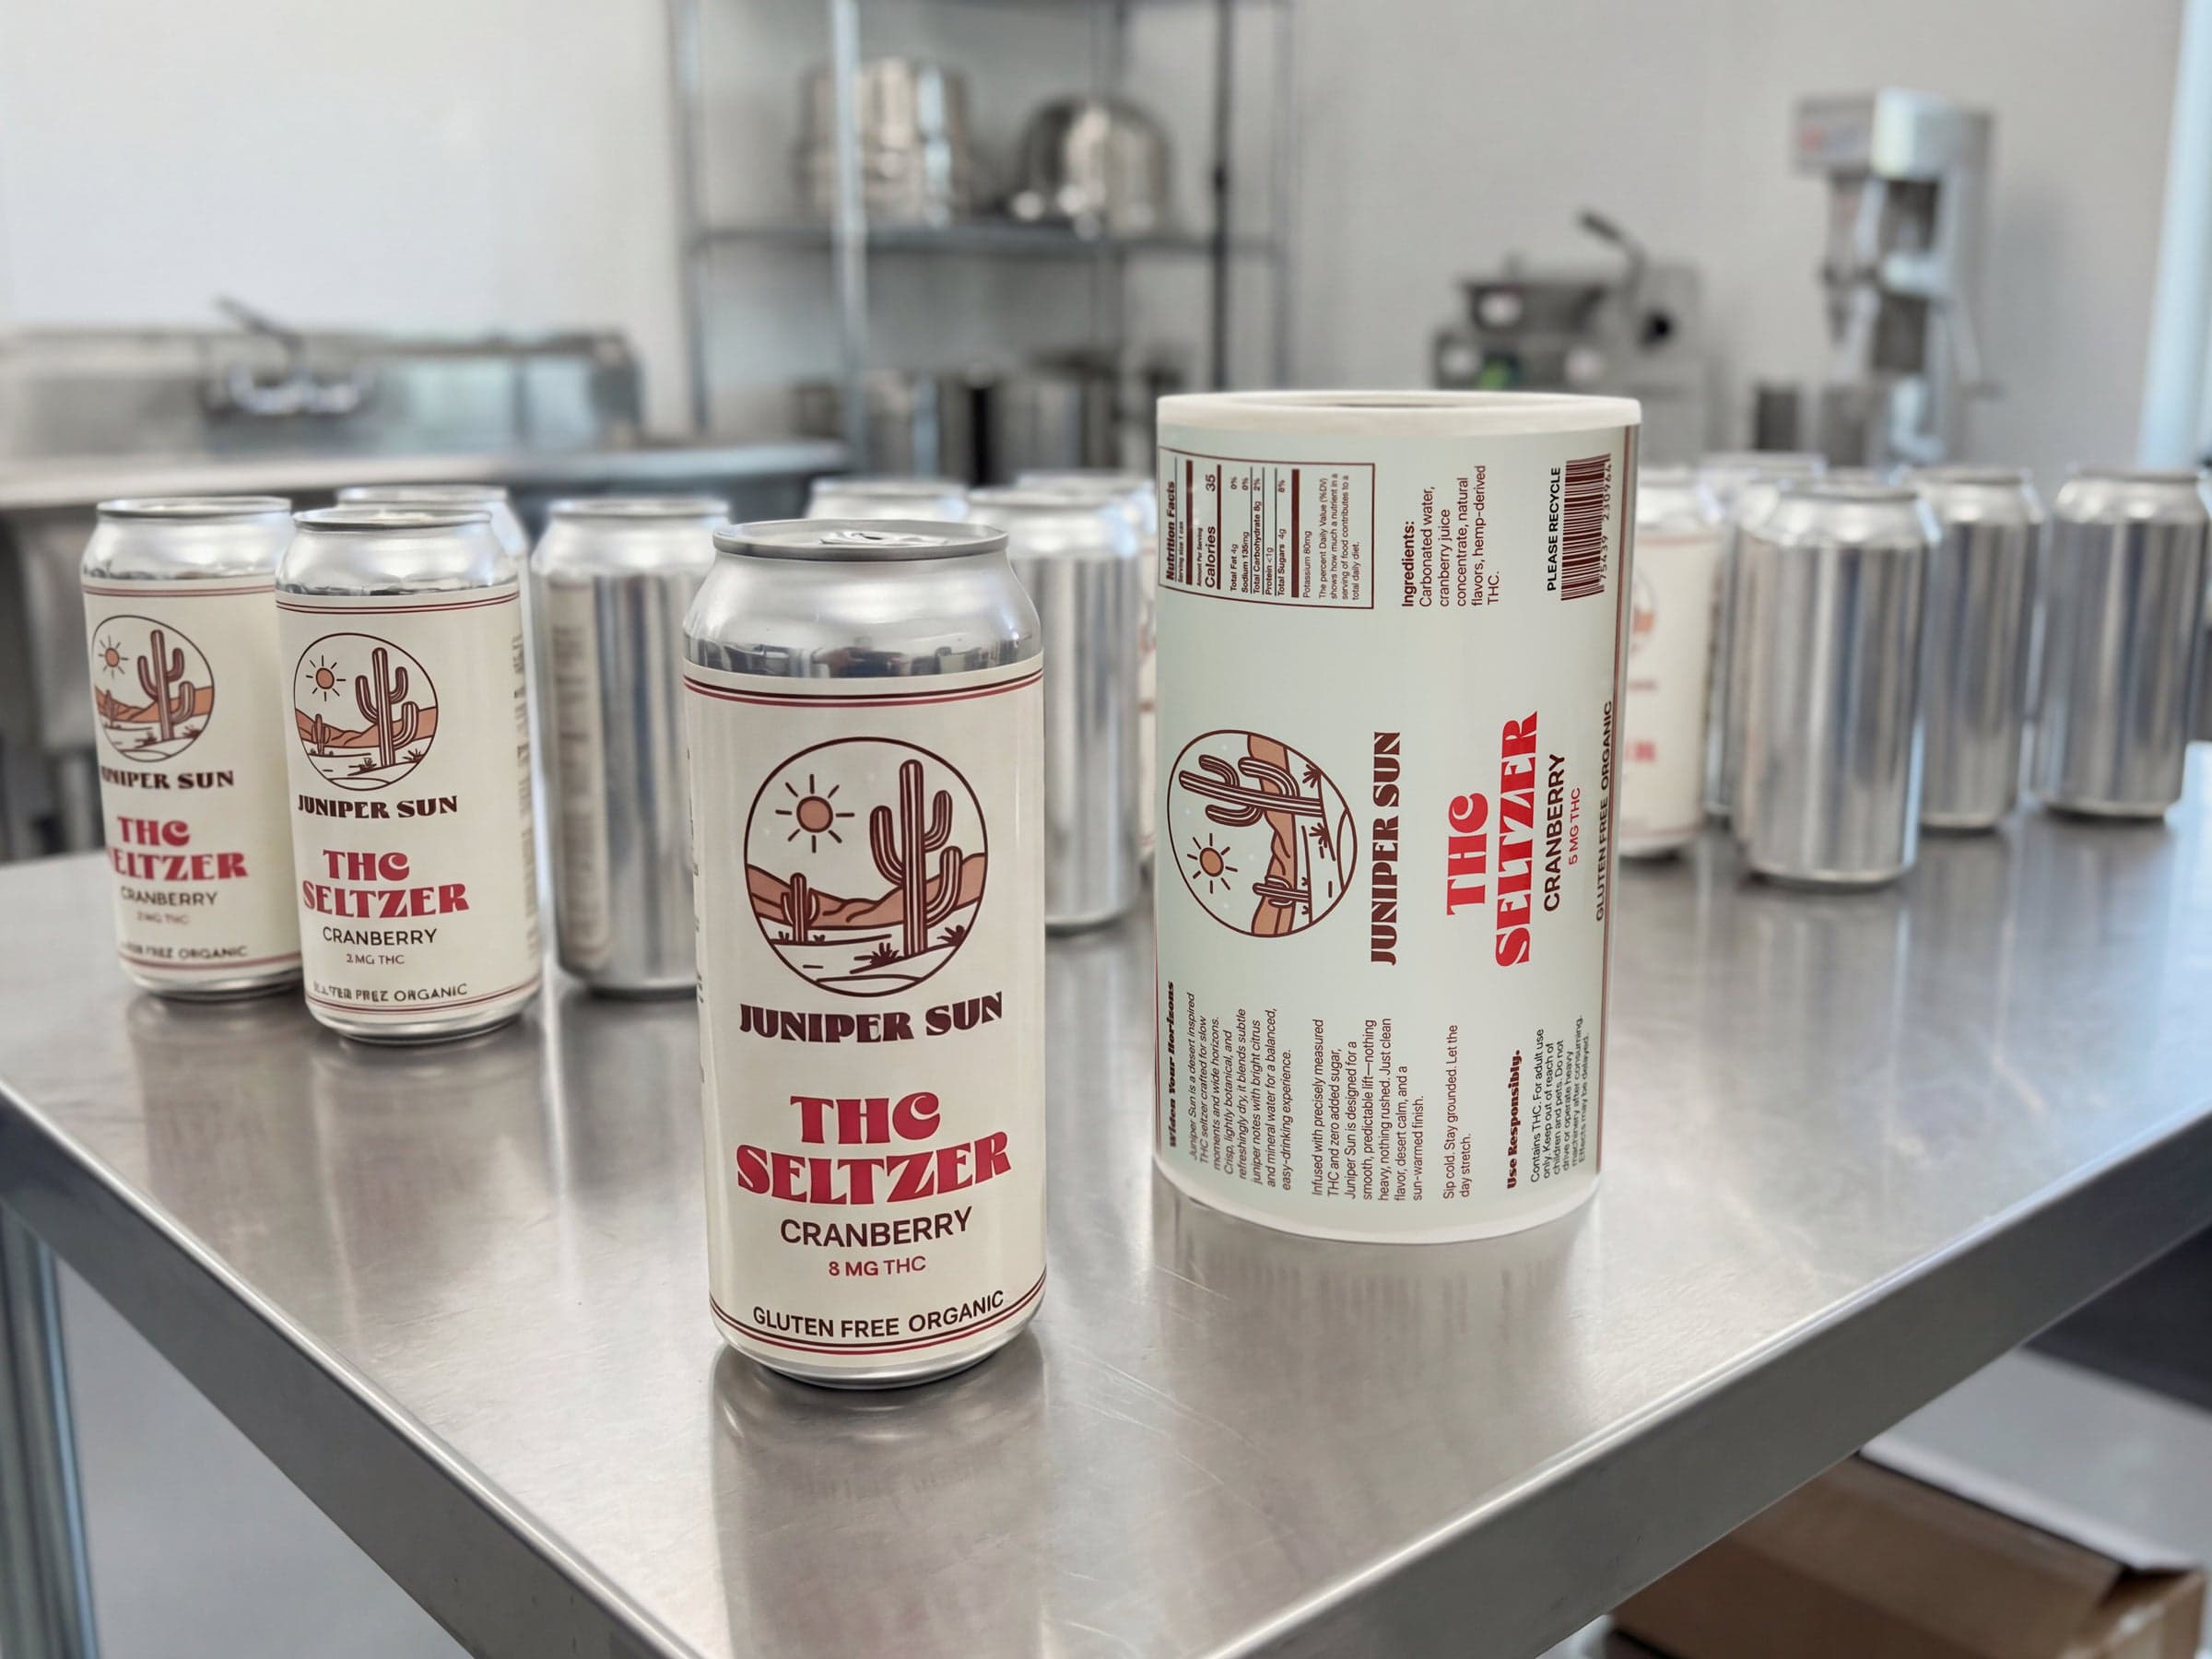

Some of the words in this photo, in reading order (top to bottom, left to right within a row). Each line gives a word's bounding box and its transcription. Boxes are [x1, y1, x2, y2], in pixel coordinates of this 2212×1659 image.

[1166, 481, 1175, 518] Facts
[1205, 474, 1216, 492] 35
[1456, 477, 1468, 521] natural
[1548, 467, 1560, 533] RECYCLE
[1421, 487, 1436, 525] water,
[1472, 465, 1487, 557] hemp-derived
[1253, 513, 1262, 572] Carbohydrate
[1438, 509, 1453, 542] juice
[1166, 522, 1175, 581] Nutrition
[1205, 526, 1216, 588] Calories
[1277, 544, 1287, 575] Sugars
[1401, 521, 1418, 607] Ingredients:
[1418, 528, 1432, 607] Carbonated
[1456, 524, 1469, 606] concentrate,
[1547, 535, 1558, 592] PLEASE
[1241, 561, 1249, 594] Sodium
[1277, 576, 1286, 596] Total
[1302, 556, 1311, 598] Potassium
[1437, 544, 1453, 607] cranberry
[1471, 559, 1486, 606] flavors,
[1487, 571, 1500, 606] THC.
[1601, 700, 1612, 790] ORGANIC
[177, 771, 234, 789] SUN
[1372, 731, 1401, 807] SUN
[298, 794, 390, 818] JUNIPER
[396, 795, 458, 818] SUN
[1570, 787, 1581, 823] THC
[1599, 796, 1608, 845] FREE
[117, 816, 190, 847] THC
[1495, 711, 1537, 967] SELTZER
[1544, 754, 1565, 912] CRANBERRY
[1569, 825, 1580, 853] MG
[112, 847, 248, 881] ELTZER
[323, 849, 410, 881] THC
[1446, 793, 1488, 916] THC
[1568, 853, 1578, 865] 5
[121, 886, 218, 906] CRANBERRY
[302, 880, 470, 918] SELTZER
[1371, 815, 1399, 966] JUNIPER
[1595, 847, 1606, 922] GLUTEN
[323, 926, 438, 946] CRANBERRY
[378, 954, 406, 965] THC
[394, 982, 468, 1002] ORGANIC
[739, 1003, 915, 1043] JUNIPER
[924, 991, 1003, 1037] SUN
[1166, 981, 1175, 1055] Horizons
[1235, 1008, 1246, 1043] subtle
[1379, 1018, 1392, 1049] clean
[1446, 1025, 1458, 1043] the
[1222, 1030, 1232, 1053] and
[1250, 1019, 1261, 1051] citrus
[1265, 1008, 1277, 1062] balanced,
[1312, 1018, 1324, 1076] measured
[1545, 1042, 1554, 1053] of
[1236, 1045, 1246, 1083] blends
[1250, 1053, 1263, 1086] bright
[1331, 1049, 1343, 1082] sugar,
[1345, 1050, 1357, 1065] for
[1378, 1052, 1391, 1076] Just
[1445, 1046, 1457, 1065] Let
[1534, 1051, 1543, 1080] adult
[1545, 1055, 1554, 1088] reach
[1222, 1055, 1234, 1107] botanical,
[1265, 1073, 1276, 1089] for
[1280, 1050, 1293, 1113] experience.
[1345, 1068, 1359, 1120] designed
[1378, 1077, 1391, 1119] rushed.
[1395, 1076, 1407, 1097] and
[1445, 1065, 1459, 1123] grounded.
[1533, 1082, 1542, 1100] For
[1544, 1089, 1552, 1100] of
[1236, 1095, 1249, 1114] dry,
[1250, 1088, 1261, 1111] with
[1265, 1090, 1276, 1122] water
[1312, 1077, 1326, 1127] precisely
[1327, 1084, 1340, 1121] added
[1394, 1099, 1409, 1129] calm,
[1411, 1095, 1424, 1128] finish.
[1508, 1049, 1523, 1156] Responsibly.
[1532, 1101, 1542, 1131] THC.
[1544, 1102, 1552, 1122] out
[789, 1091, 941, 1146] THC
[1168, 1098, 1177, 1147] Widen
[1223, 1108, 1235, 1142] lightly
[1252, 1113, 1261, 1145] notes
[1330, 1122, 1340, 1147] zero
[1344, 1123, 1357, 1132] is
[1360, 1091, 1375, 1154] predictable
[1237, 1115, 1249, 1180] refreshingly
[1265, 1123, 1276, 1164] mineral
[1279, 1115, 1294, 1191] easy-drinking
[1312, 1129, 1324, 1152] with
[1344, 1134, 1357, 1156] Sun
[1378, 1122, 1393, 1164] nothing
[1394, 1131, 1406, 1167] desert
[1443, 1125, 1459, 1150] Stay
[1460, 1133, 1471, 1175] stretch.
[1542, 1123, 1553, 1152] Keep
[736, 1131, 1012, 1206] SELTZER
[1223, 1145, 1235, 1175] Crisp,
[1251, 1146, 1264, 1185] juniper
[1311, 1154, 1324, 1195] Infused
[1327, 1147, 1339, 1170] and
[1411, 1131, 1423, 1201] sun-warmed
[1443, 1152, 1455, 1179] cold.
[1507, 1158, 1517, 1189] Use
[1530, 1133, 1542, 1182] Contains
[1542, 1153, 1553, 1179] only.
[1265, 1165, 1276, 1187] and
[1327, 1171, 1340, 1197] THC
[1344, 1158, 1359, 1200] Juniper
[1360, 1156, 1375, 1200] smooth,
[1377, 1166, 1393, 1201] heavy,
[1394, 1169, 1408, 1201] flavor,
[1442, 1181, 1457, 1199] Sip
[1459, 1177, 1473, 1198] day
[780, 1206, 972, 1248] CRANBERRY
[828, 1261, 841, 1277] 8
[844, 1261, 879, 1277] MG
[883, 1254, 926, 1275] THC
[752, 1305, 834, 1337] GLUTEN
[840, 1317, 900, 1338] FREE
[908, 1289, 1005, 1333] ORGANIC
